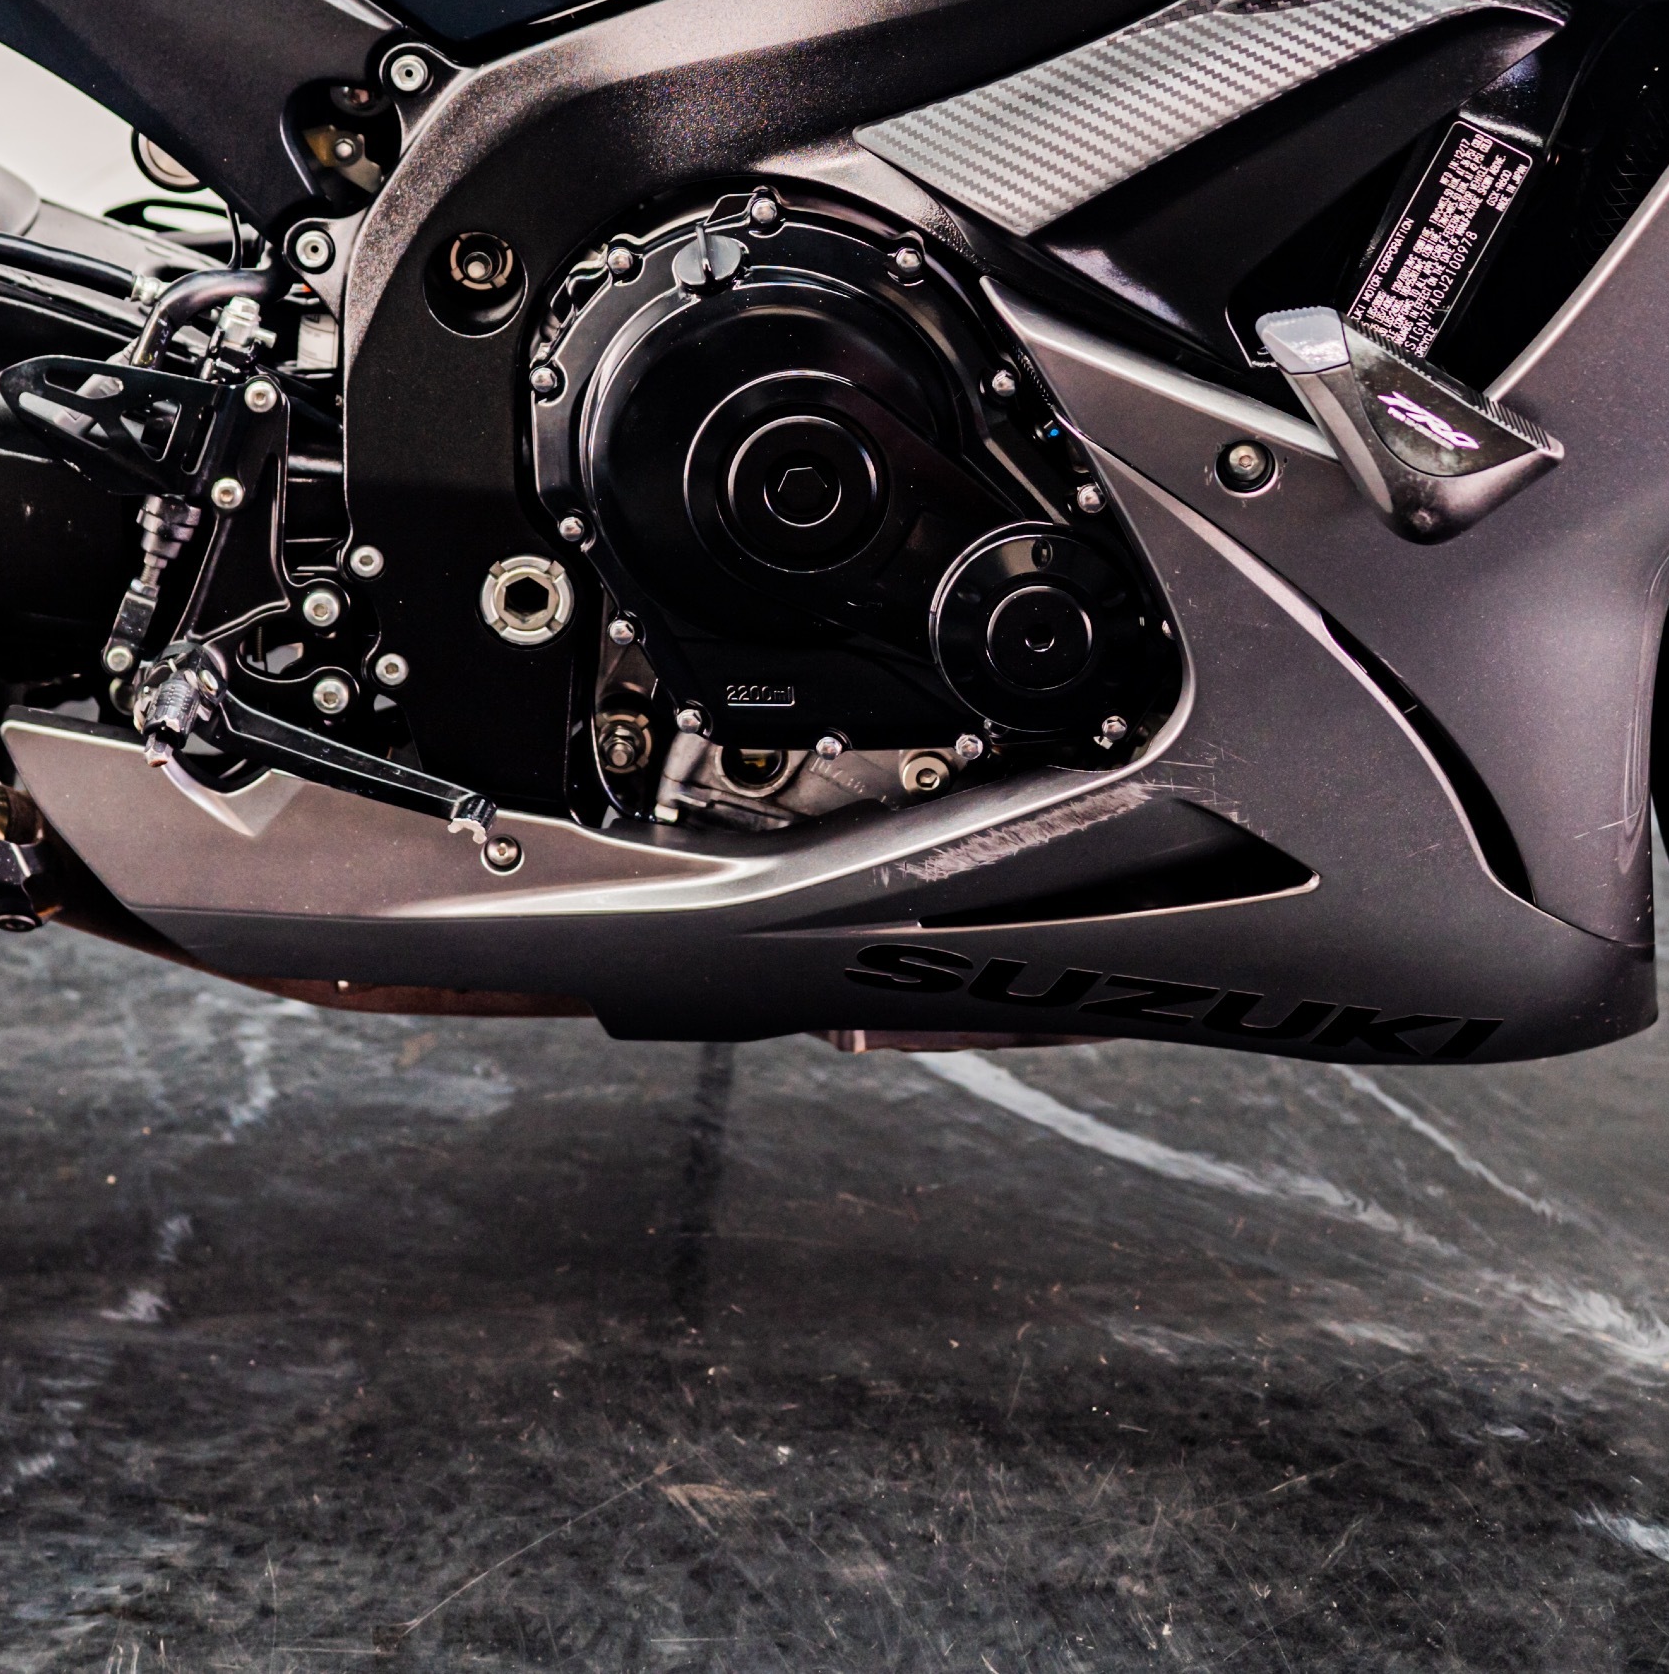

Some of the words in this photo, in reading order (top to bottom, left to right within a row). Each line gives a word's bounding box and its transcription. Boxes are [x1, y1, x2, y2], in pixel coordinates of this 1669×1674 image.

[1468, 163, 1489, 191] VEHICLE
[1476, 174, 1494, 196] SHOWN
[1485, 168, 1513, 207] GSX-R600
[1494, 193, 1511, 212] MADE
[1504, 183, 1516, 194] IN
[1510, 162, 1528, 185] JAPAN
[1457, 190, 1474, 212] MOTOR
[1442, 211, 1463, 239] FEDERAL
[1454, 195, 1483, 236] MANUFACTURE
[1448, 235, 1460, 246] OF
[1361, 273, 1383, 302] MOTOR
[1376, 215, 1415, 274] CORPORATION
[1422, 238, 1448, 275] APPLICABLE
[1439, 245, 1455, 263] DATE
[1414, 276, 1427, 288] ALL
[1426, 275, 1438, 287] ON
[1432, 262, 1446, 276] THE
[1401, 229, 1479, 353] S1GN7FA0J2100978
[1409, 288, 1420, 298] TO
[1413, 286, 1432, 310] EFFECT
[1392, 298, 1415, 329] CONFORMS
[1408, 308, 1419, 319] IN
[844, 943, 1505, 1059] SUZUKI
